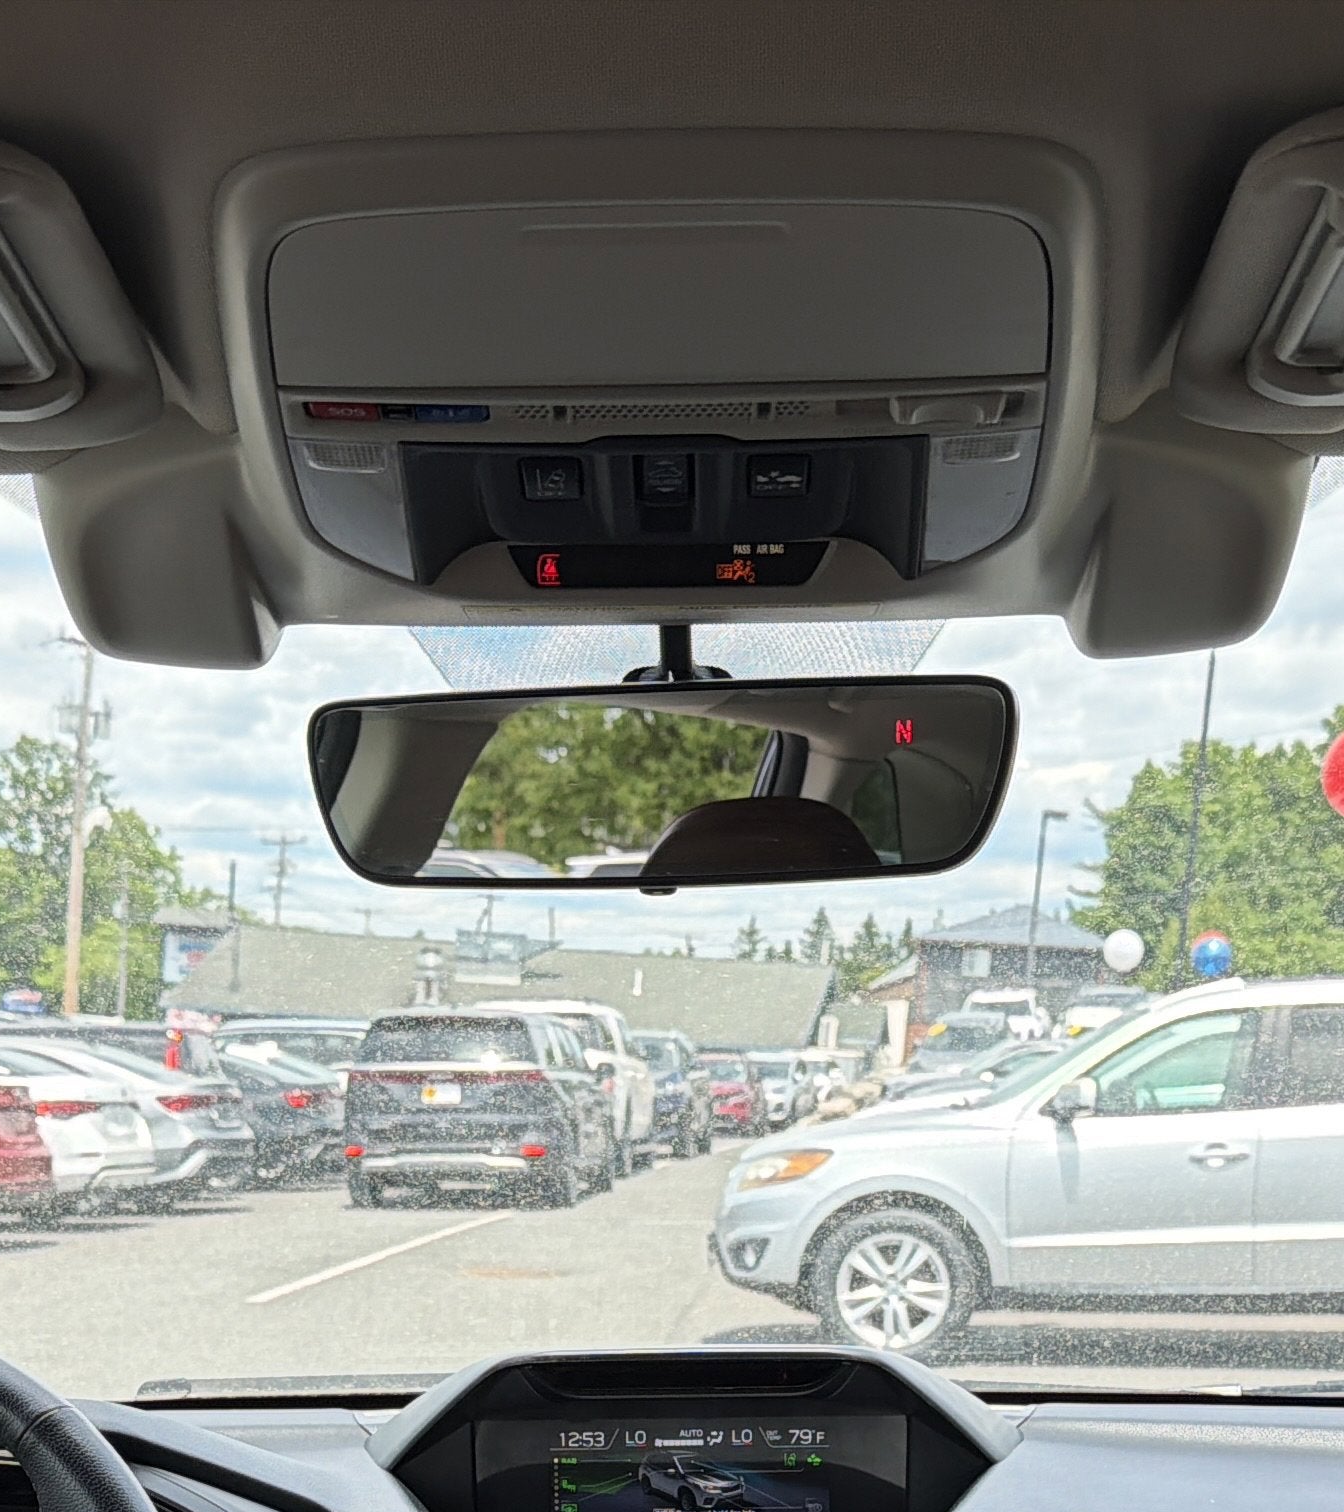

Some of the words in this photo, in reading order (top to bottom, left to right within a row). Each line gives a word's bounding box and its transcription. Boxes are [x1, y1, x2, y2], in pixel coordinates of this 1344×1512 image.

[327, 407, 365, 417] SOS
[733, 543, 751, 555] PASS
[756, 543, 768, 555] AIR
[769, 543, 785, 555] BAG
[894, 719, 914, 745] N
[558, 1431, 606, 1448] 12:53
[625, 1430, 647, 1446] LO
[679, 1429, 704, 1438] AUTO
[731, 1428, 753, 1444] LO
